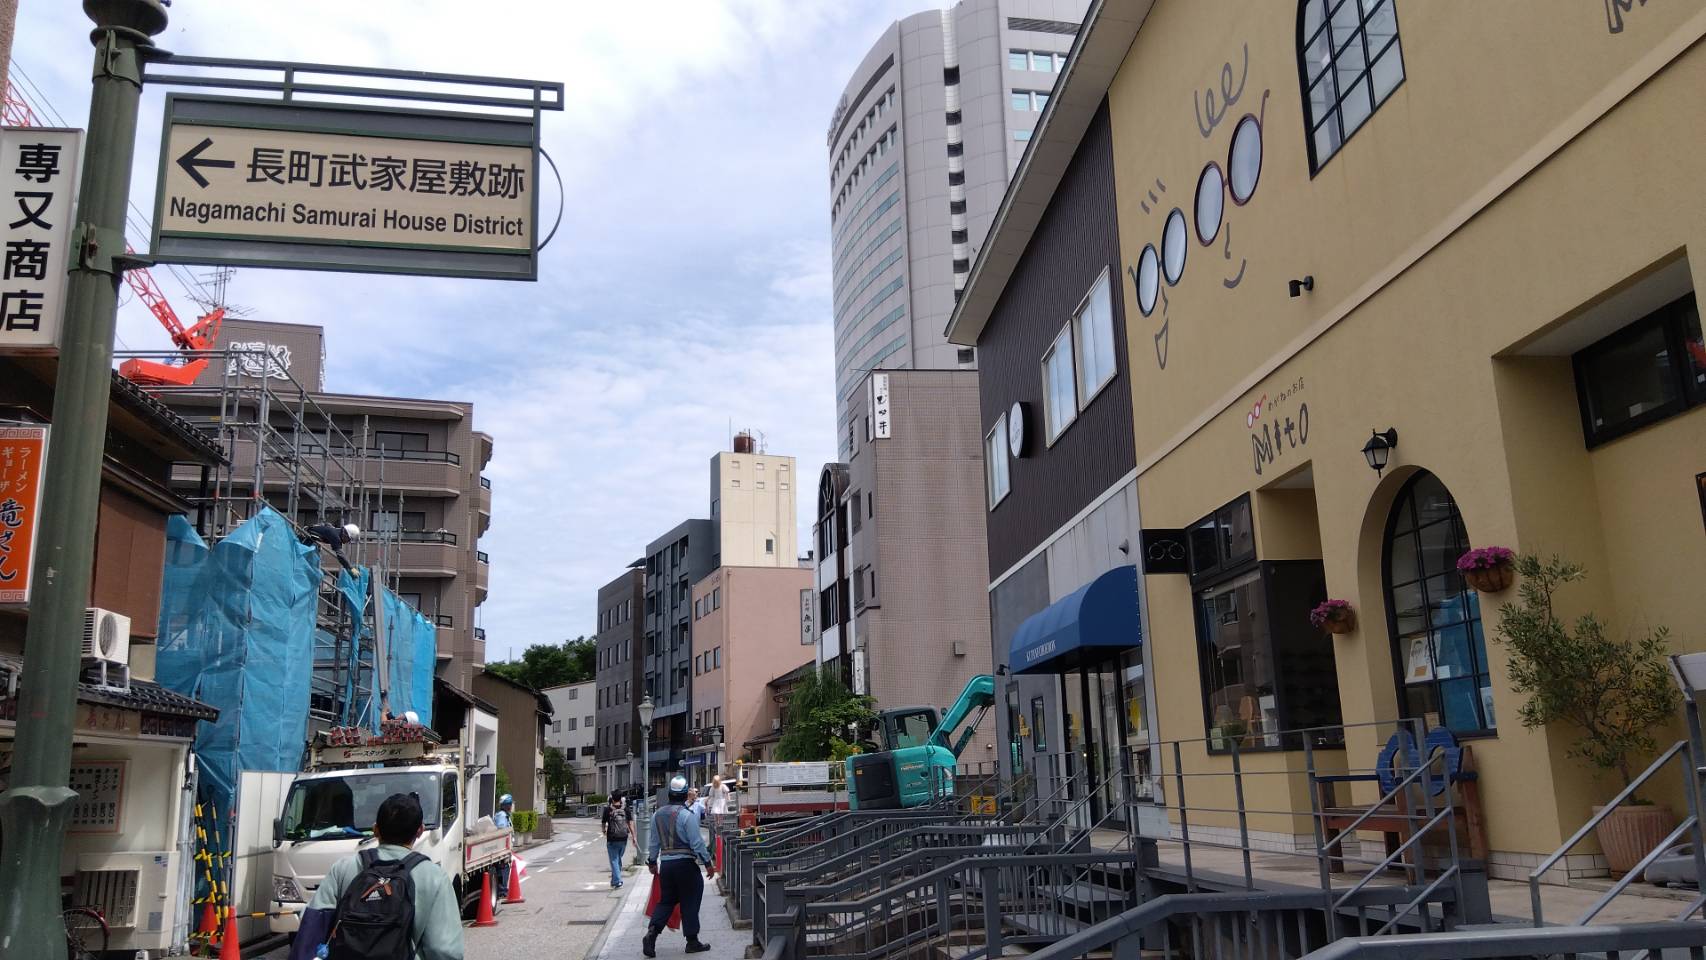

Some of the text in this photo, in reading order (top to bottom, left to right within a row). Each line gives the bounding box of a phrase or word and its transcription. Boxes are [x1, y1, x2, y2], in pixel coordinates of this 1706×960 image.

[246, 147, 525, 200] 長町武家屋敷跡
[0, 143, 62, 331] 専又商店
[169, 196, 524, 236] Nagamachi Samurai House District
[16, 447, 31, 493] ラーメン
